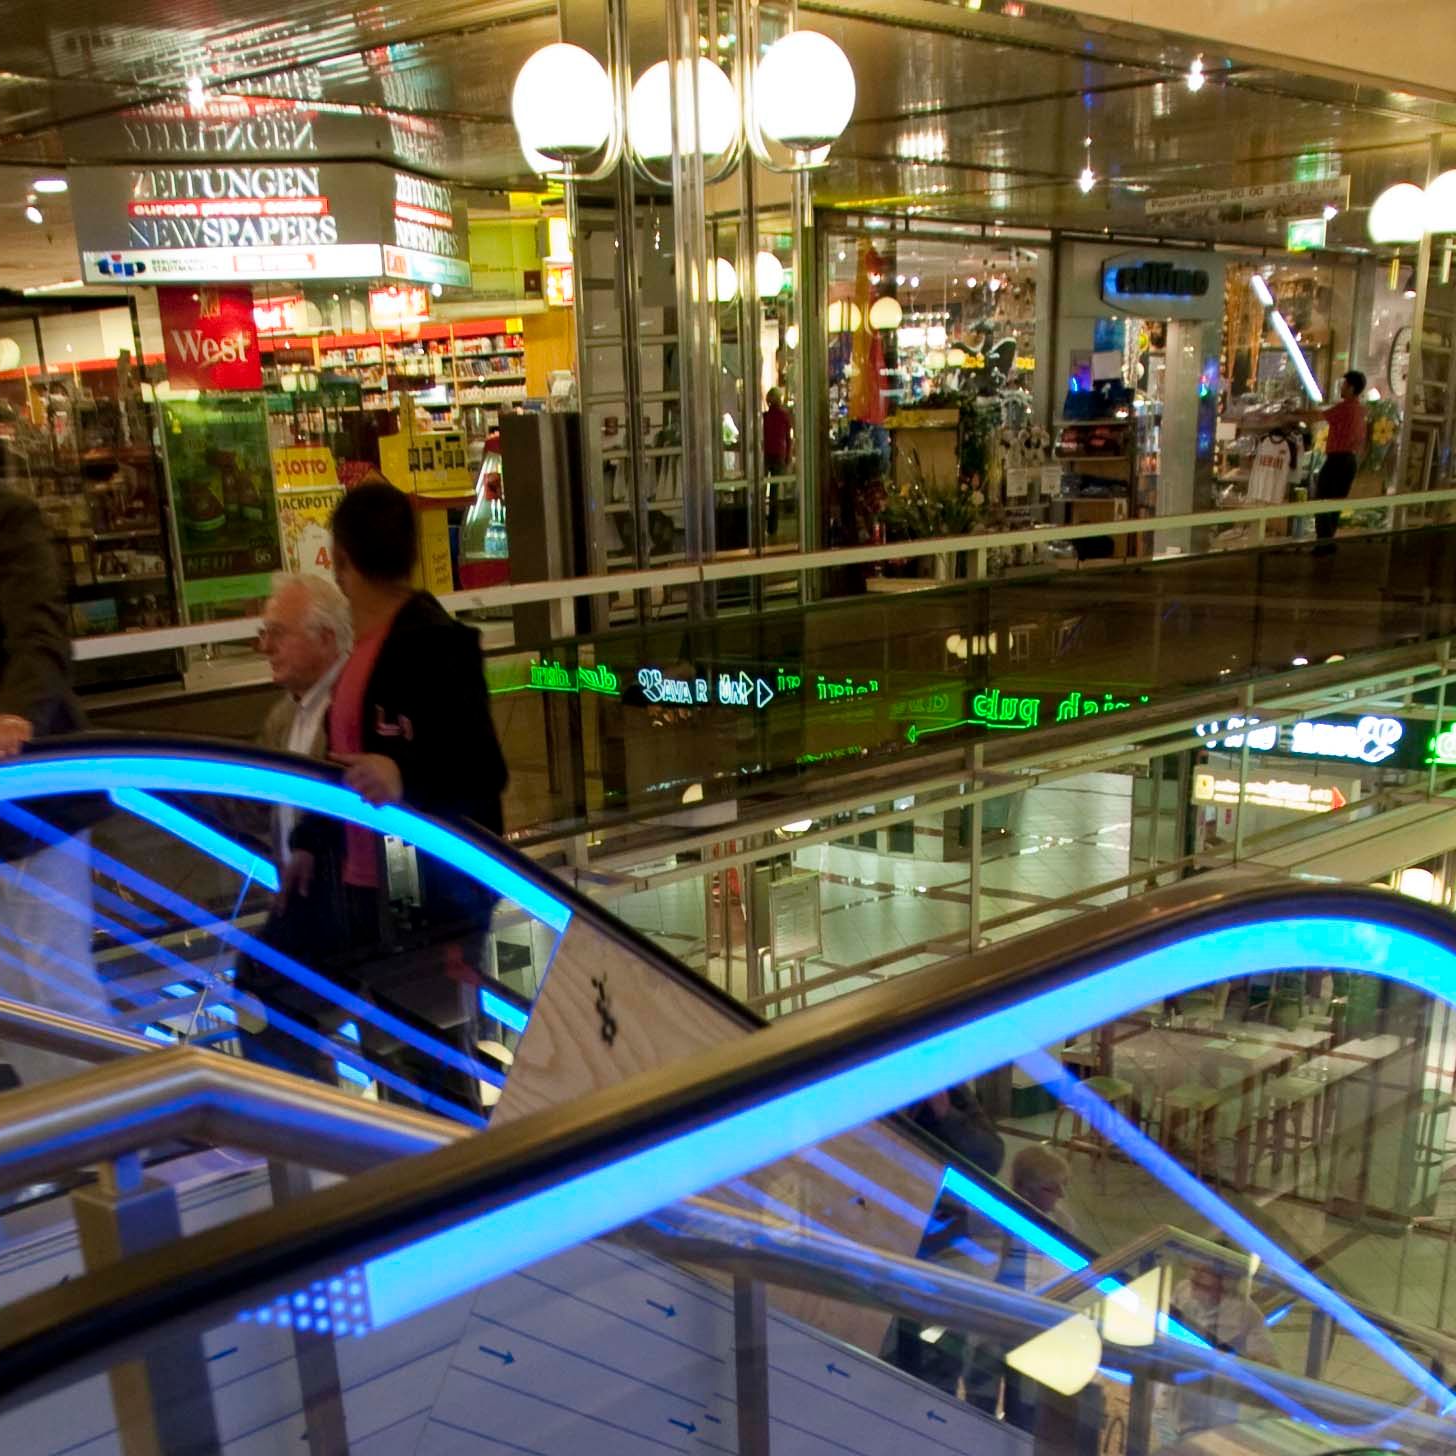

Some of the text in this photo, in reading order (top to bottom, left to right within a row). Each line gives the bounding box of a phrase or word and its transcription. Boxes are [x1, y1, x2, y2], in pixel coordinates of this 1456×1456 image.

[130, 166, 320, 198] ZEITUNGEN
[134, 202, 197, 216] europa
[128, 215, 339, 248] NEWSPAPERS
[96, 254, 146, 277] tip
[170, 328, 250, 364] West
[285, 459, 327, 475] LOTTO
